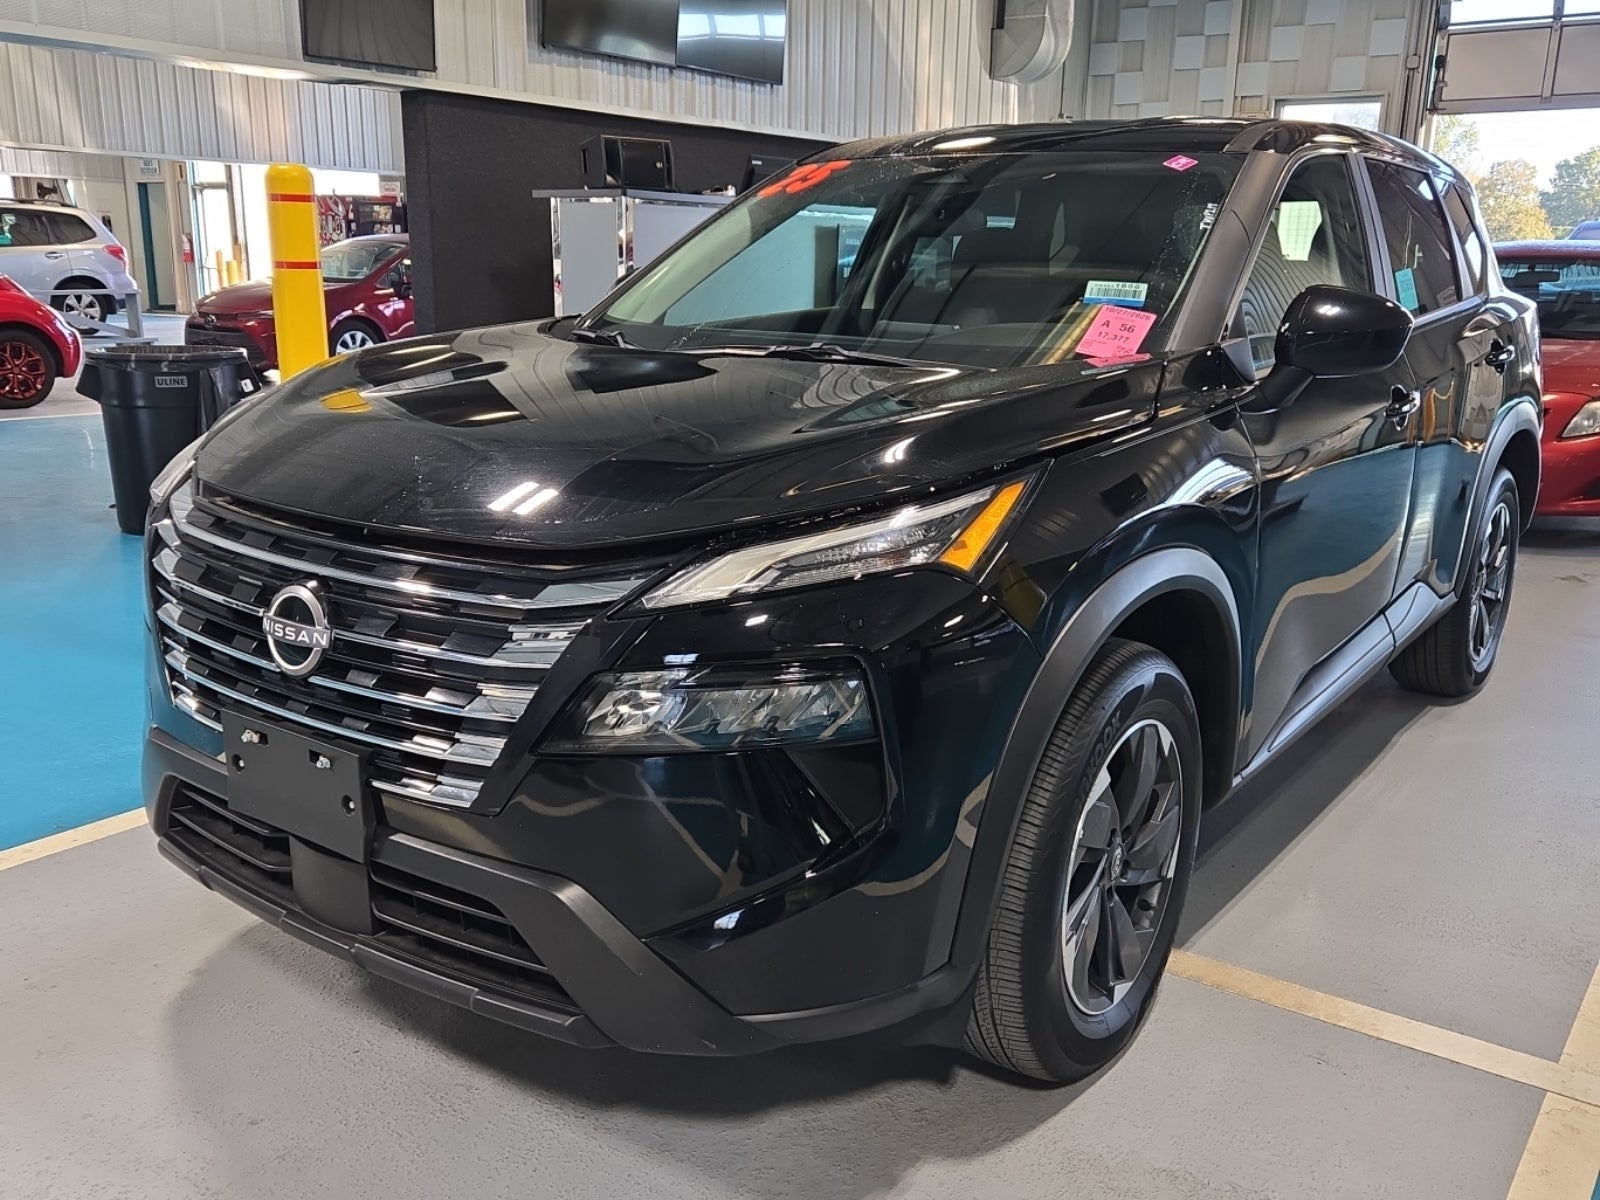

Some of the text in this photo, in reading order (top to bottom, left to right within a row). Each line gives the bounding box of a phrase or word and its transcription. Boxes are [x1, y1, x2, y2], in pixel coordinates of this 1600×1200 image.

[1101, 320, 1136, 333] A 56
[157, 377, 187, 387] ULINE
[263, 617, 327, 646] NISSAN
